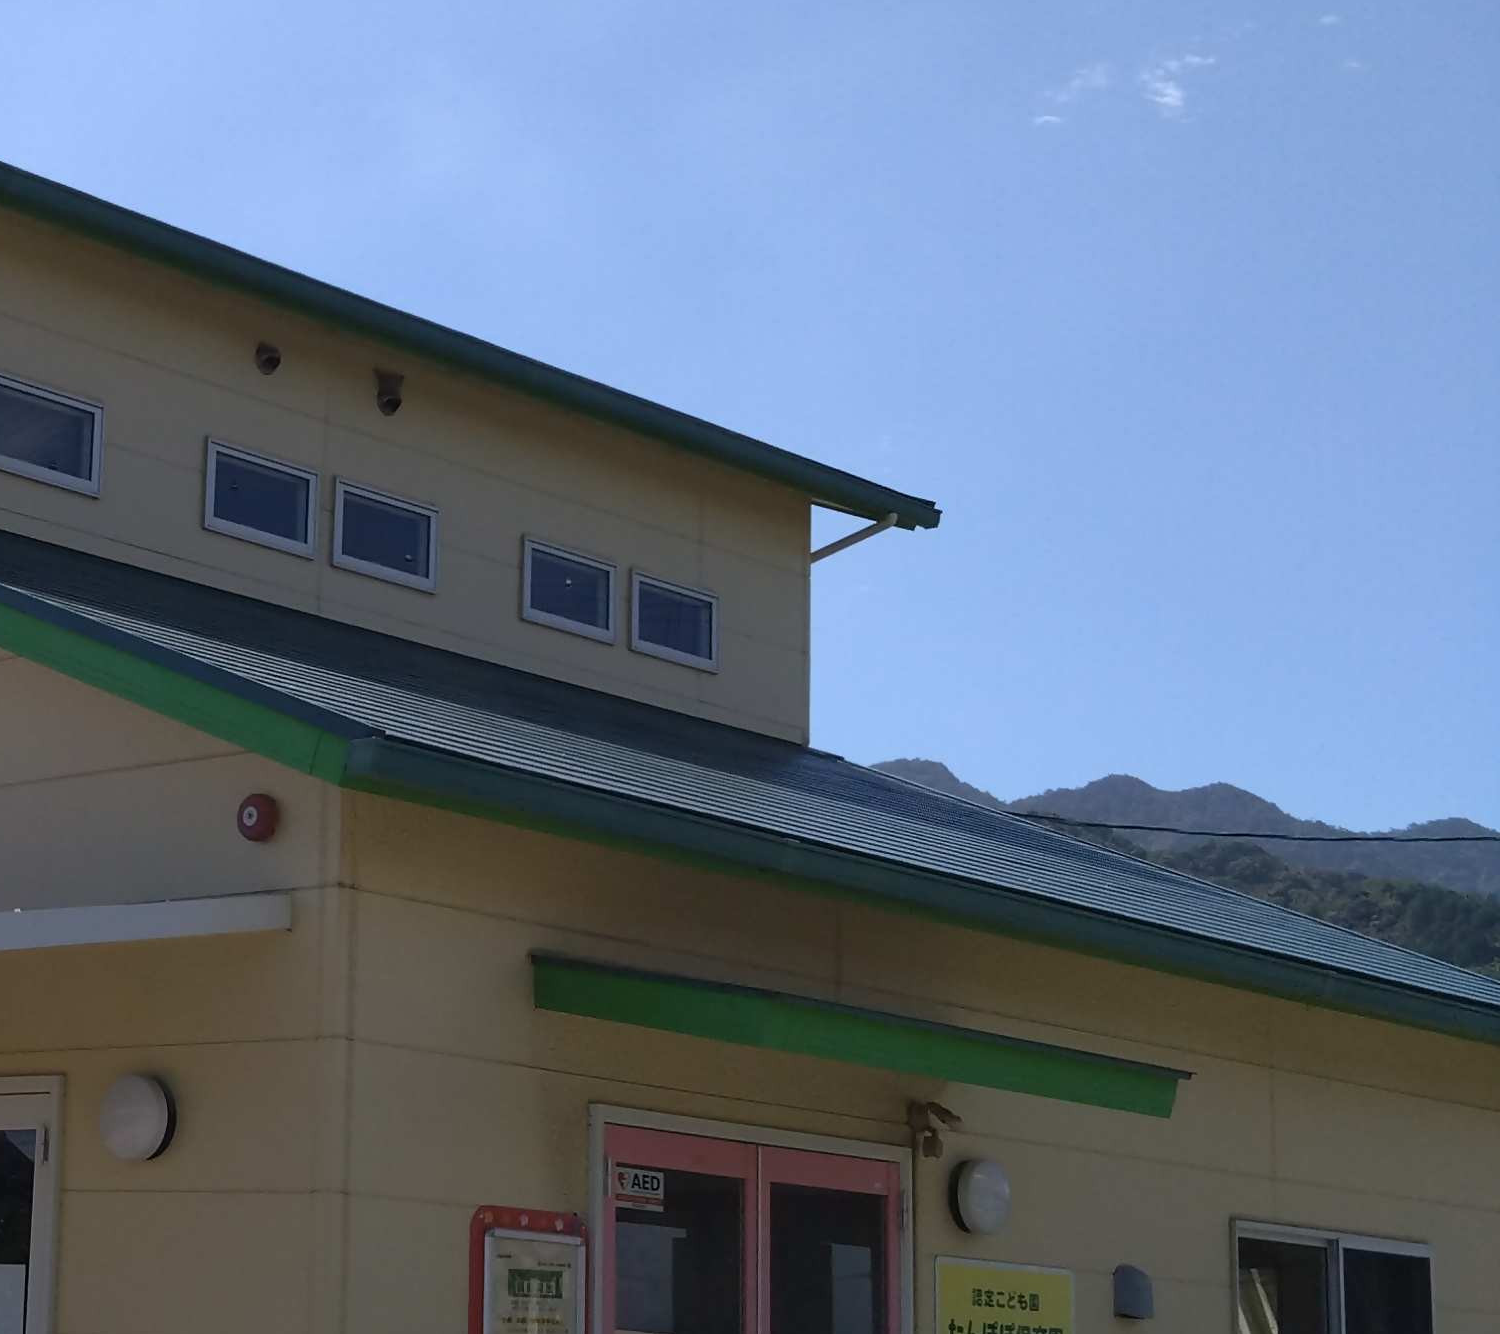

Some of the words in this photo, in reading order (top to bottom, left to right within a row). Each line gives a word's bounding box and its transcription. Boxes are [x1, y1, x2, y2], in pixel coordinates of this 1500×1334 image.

[631, 1173, 660, 1192] AED
[972, 1288, 1039, 1312] 認定こども園
